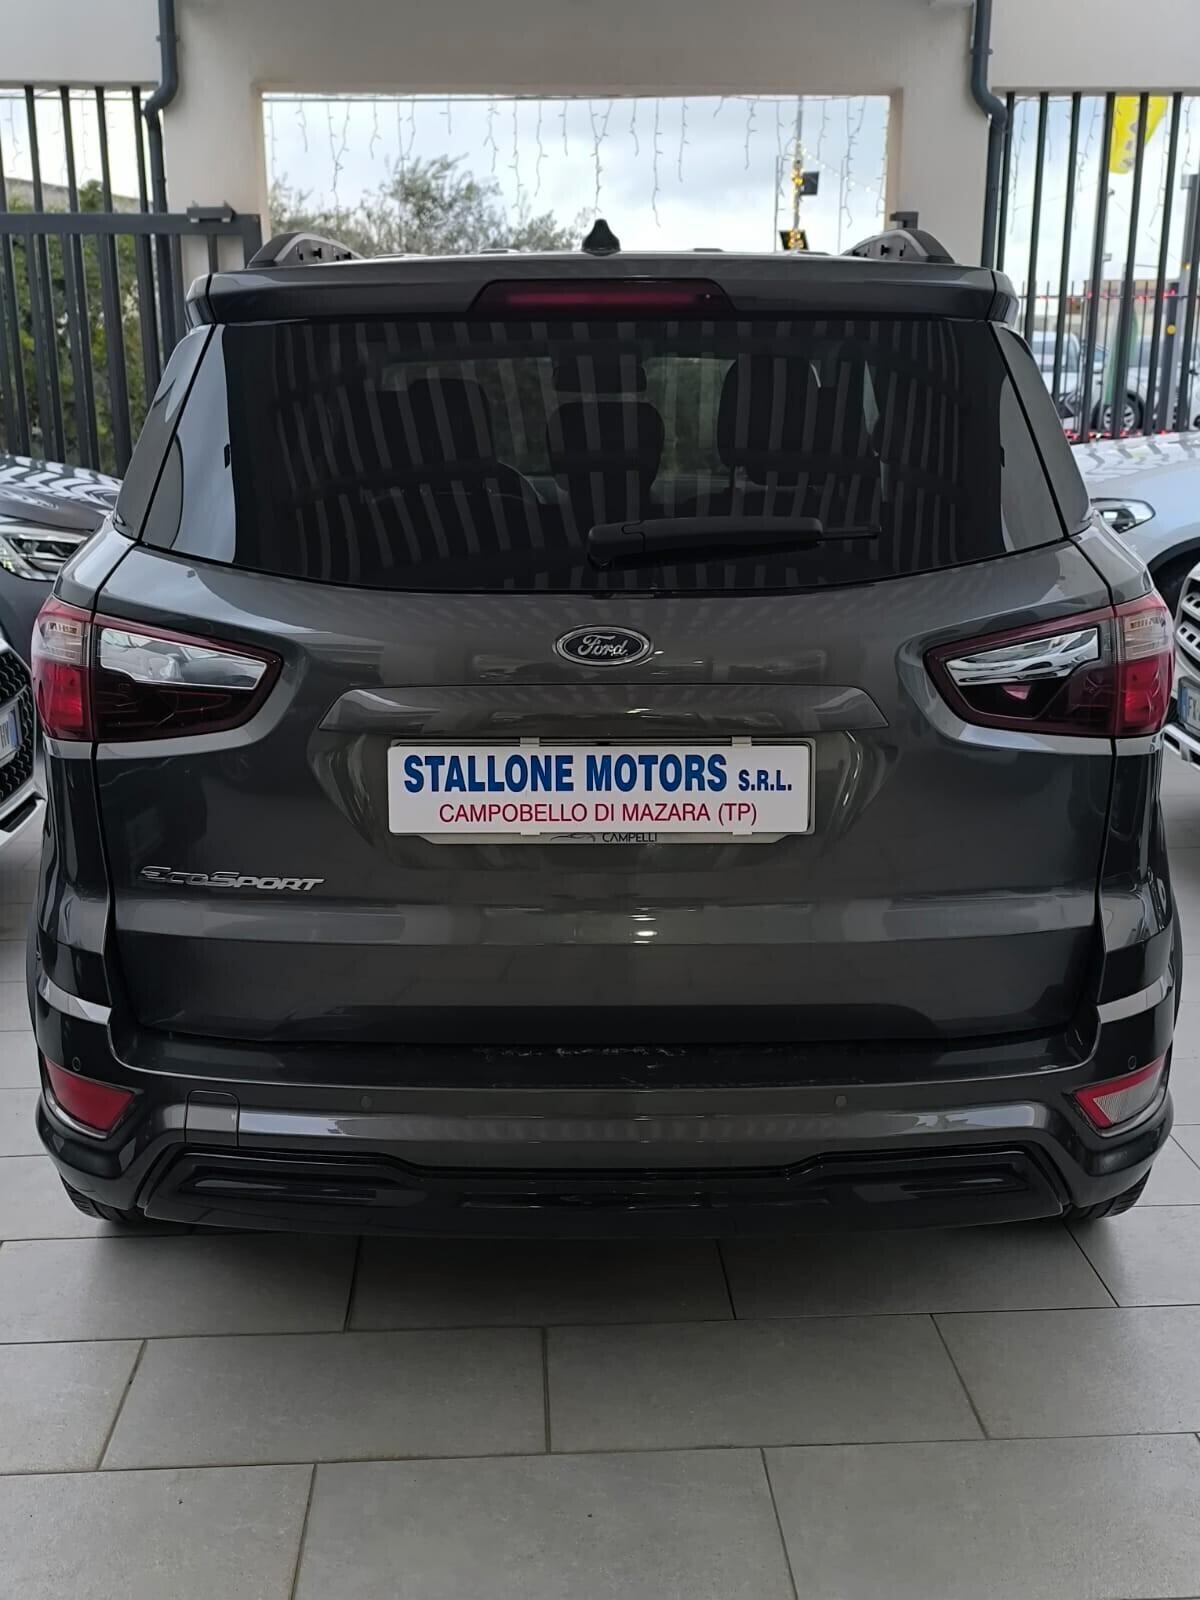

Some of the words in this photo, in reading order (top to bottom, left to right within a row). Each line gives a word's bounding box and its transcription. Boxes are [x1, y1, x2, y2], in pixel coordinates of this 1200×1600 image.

[577, 634, 629, 656] Ford
[404, 754, 573, 792] STALLONE
[586, 754, 727, 792] MOTORS
[738, 770, 793, 791] S.R.L.
[439, 804, 587, 822] CAMPOBELLO
[594, 804, 615, 821] DI
[622, 803, 710, 822] MAZARA
[717, 803, 758, 825] (TP)
[602, 832, 658, 843] CAMPELLI
